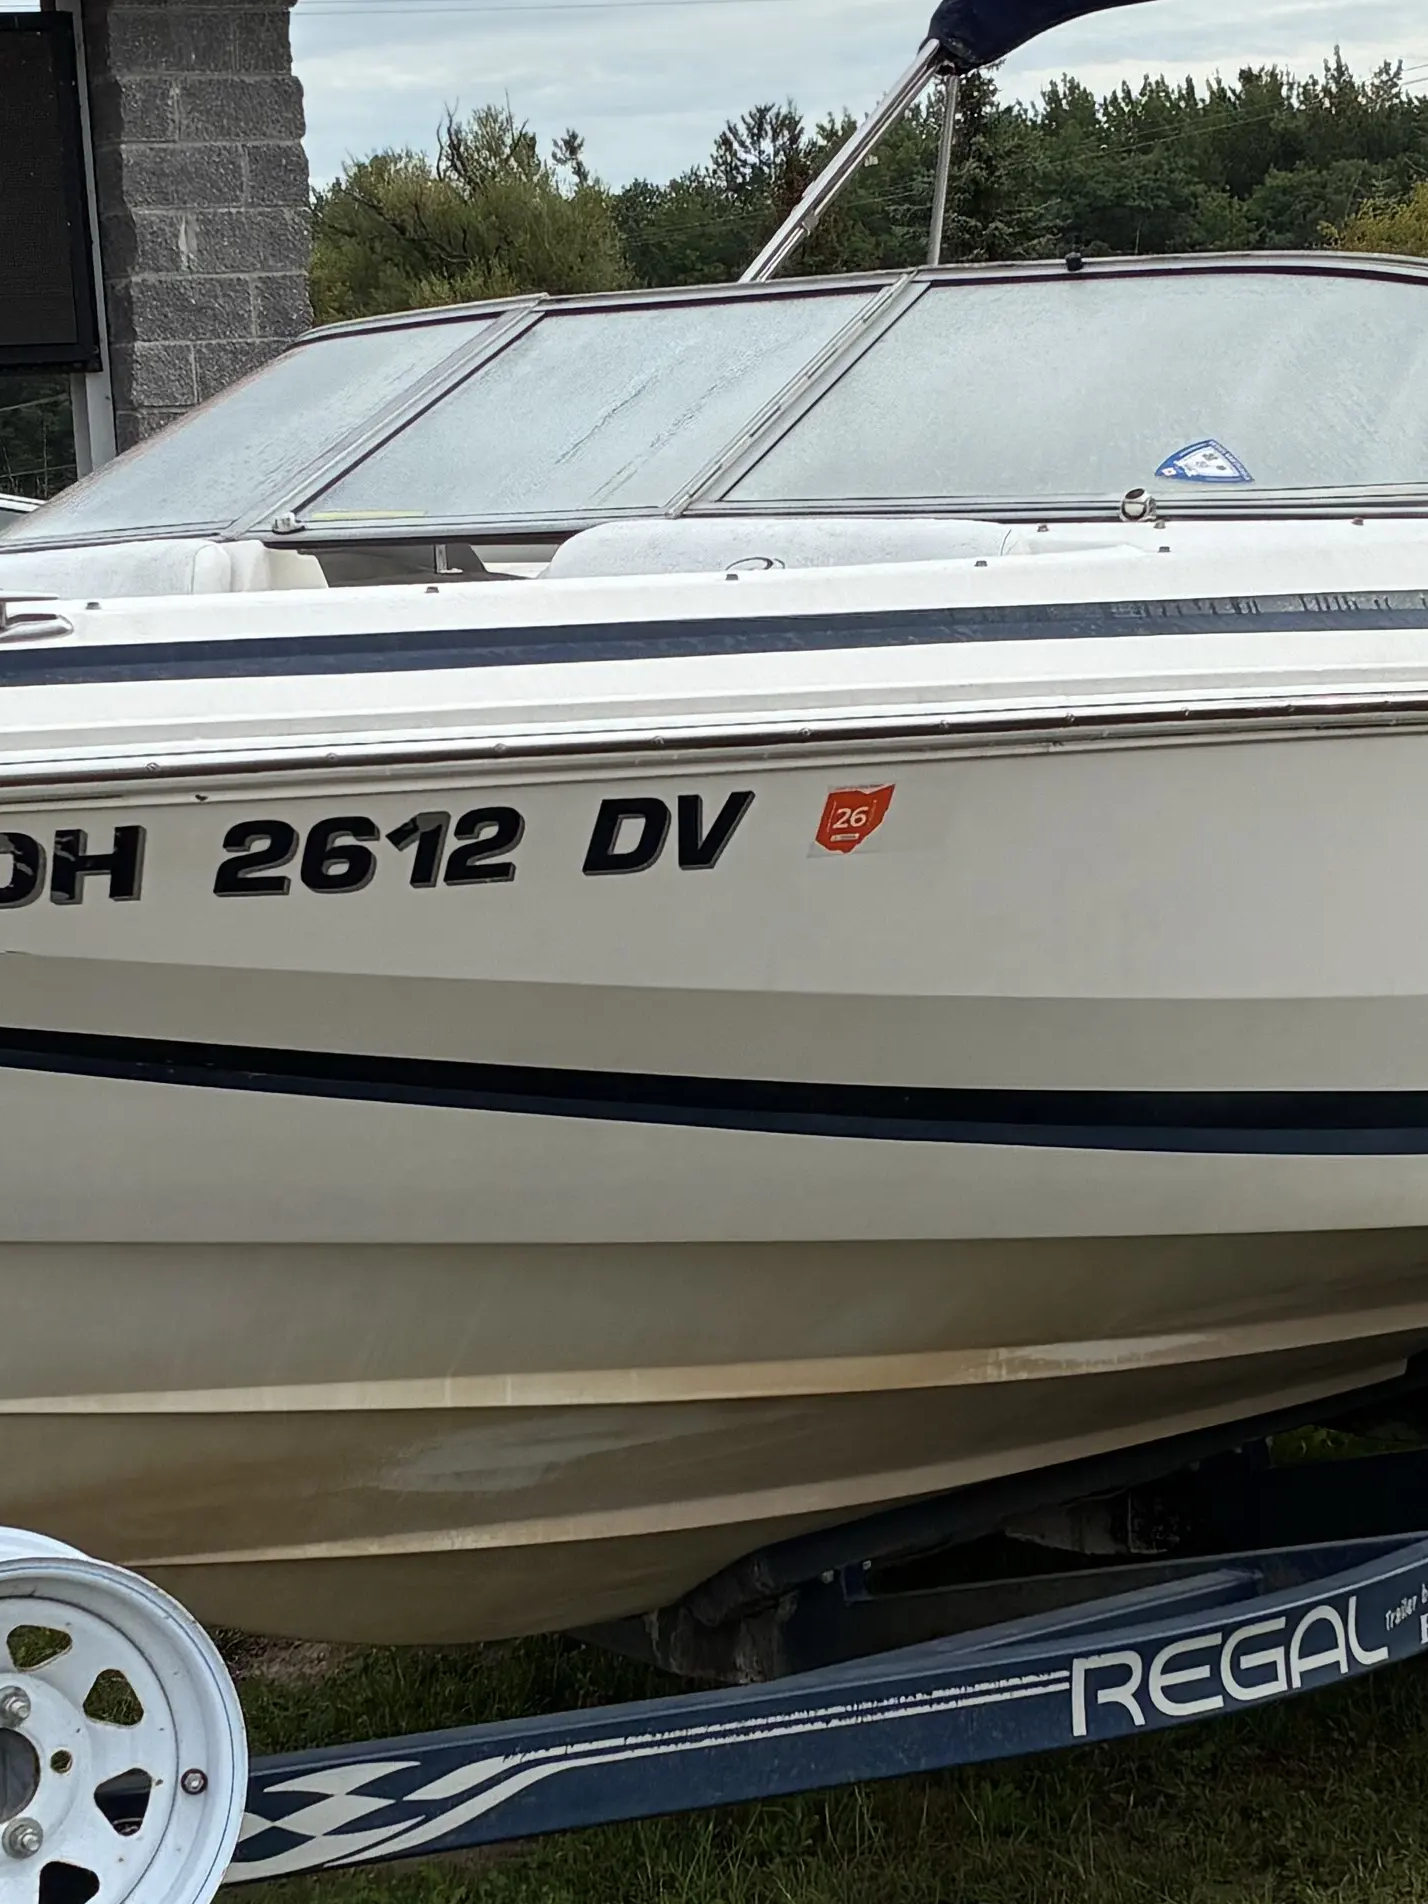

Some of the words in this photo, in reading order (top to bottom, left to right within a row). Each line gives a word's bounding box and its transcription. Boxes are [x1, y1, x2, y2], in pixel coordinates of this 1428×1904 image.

[213, 805, 526, 898] 2612
[582, 790, 756, 876] DV
[832, 806, 869, 828] 26
[1385, 1595, 1418, 1631] Trailer
[1072, 1596, 1389, 1736] REGAL
